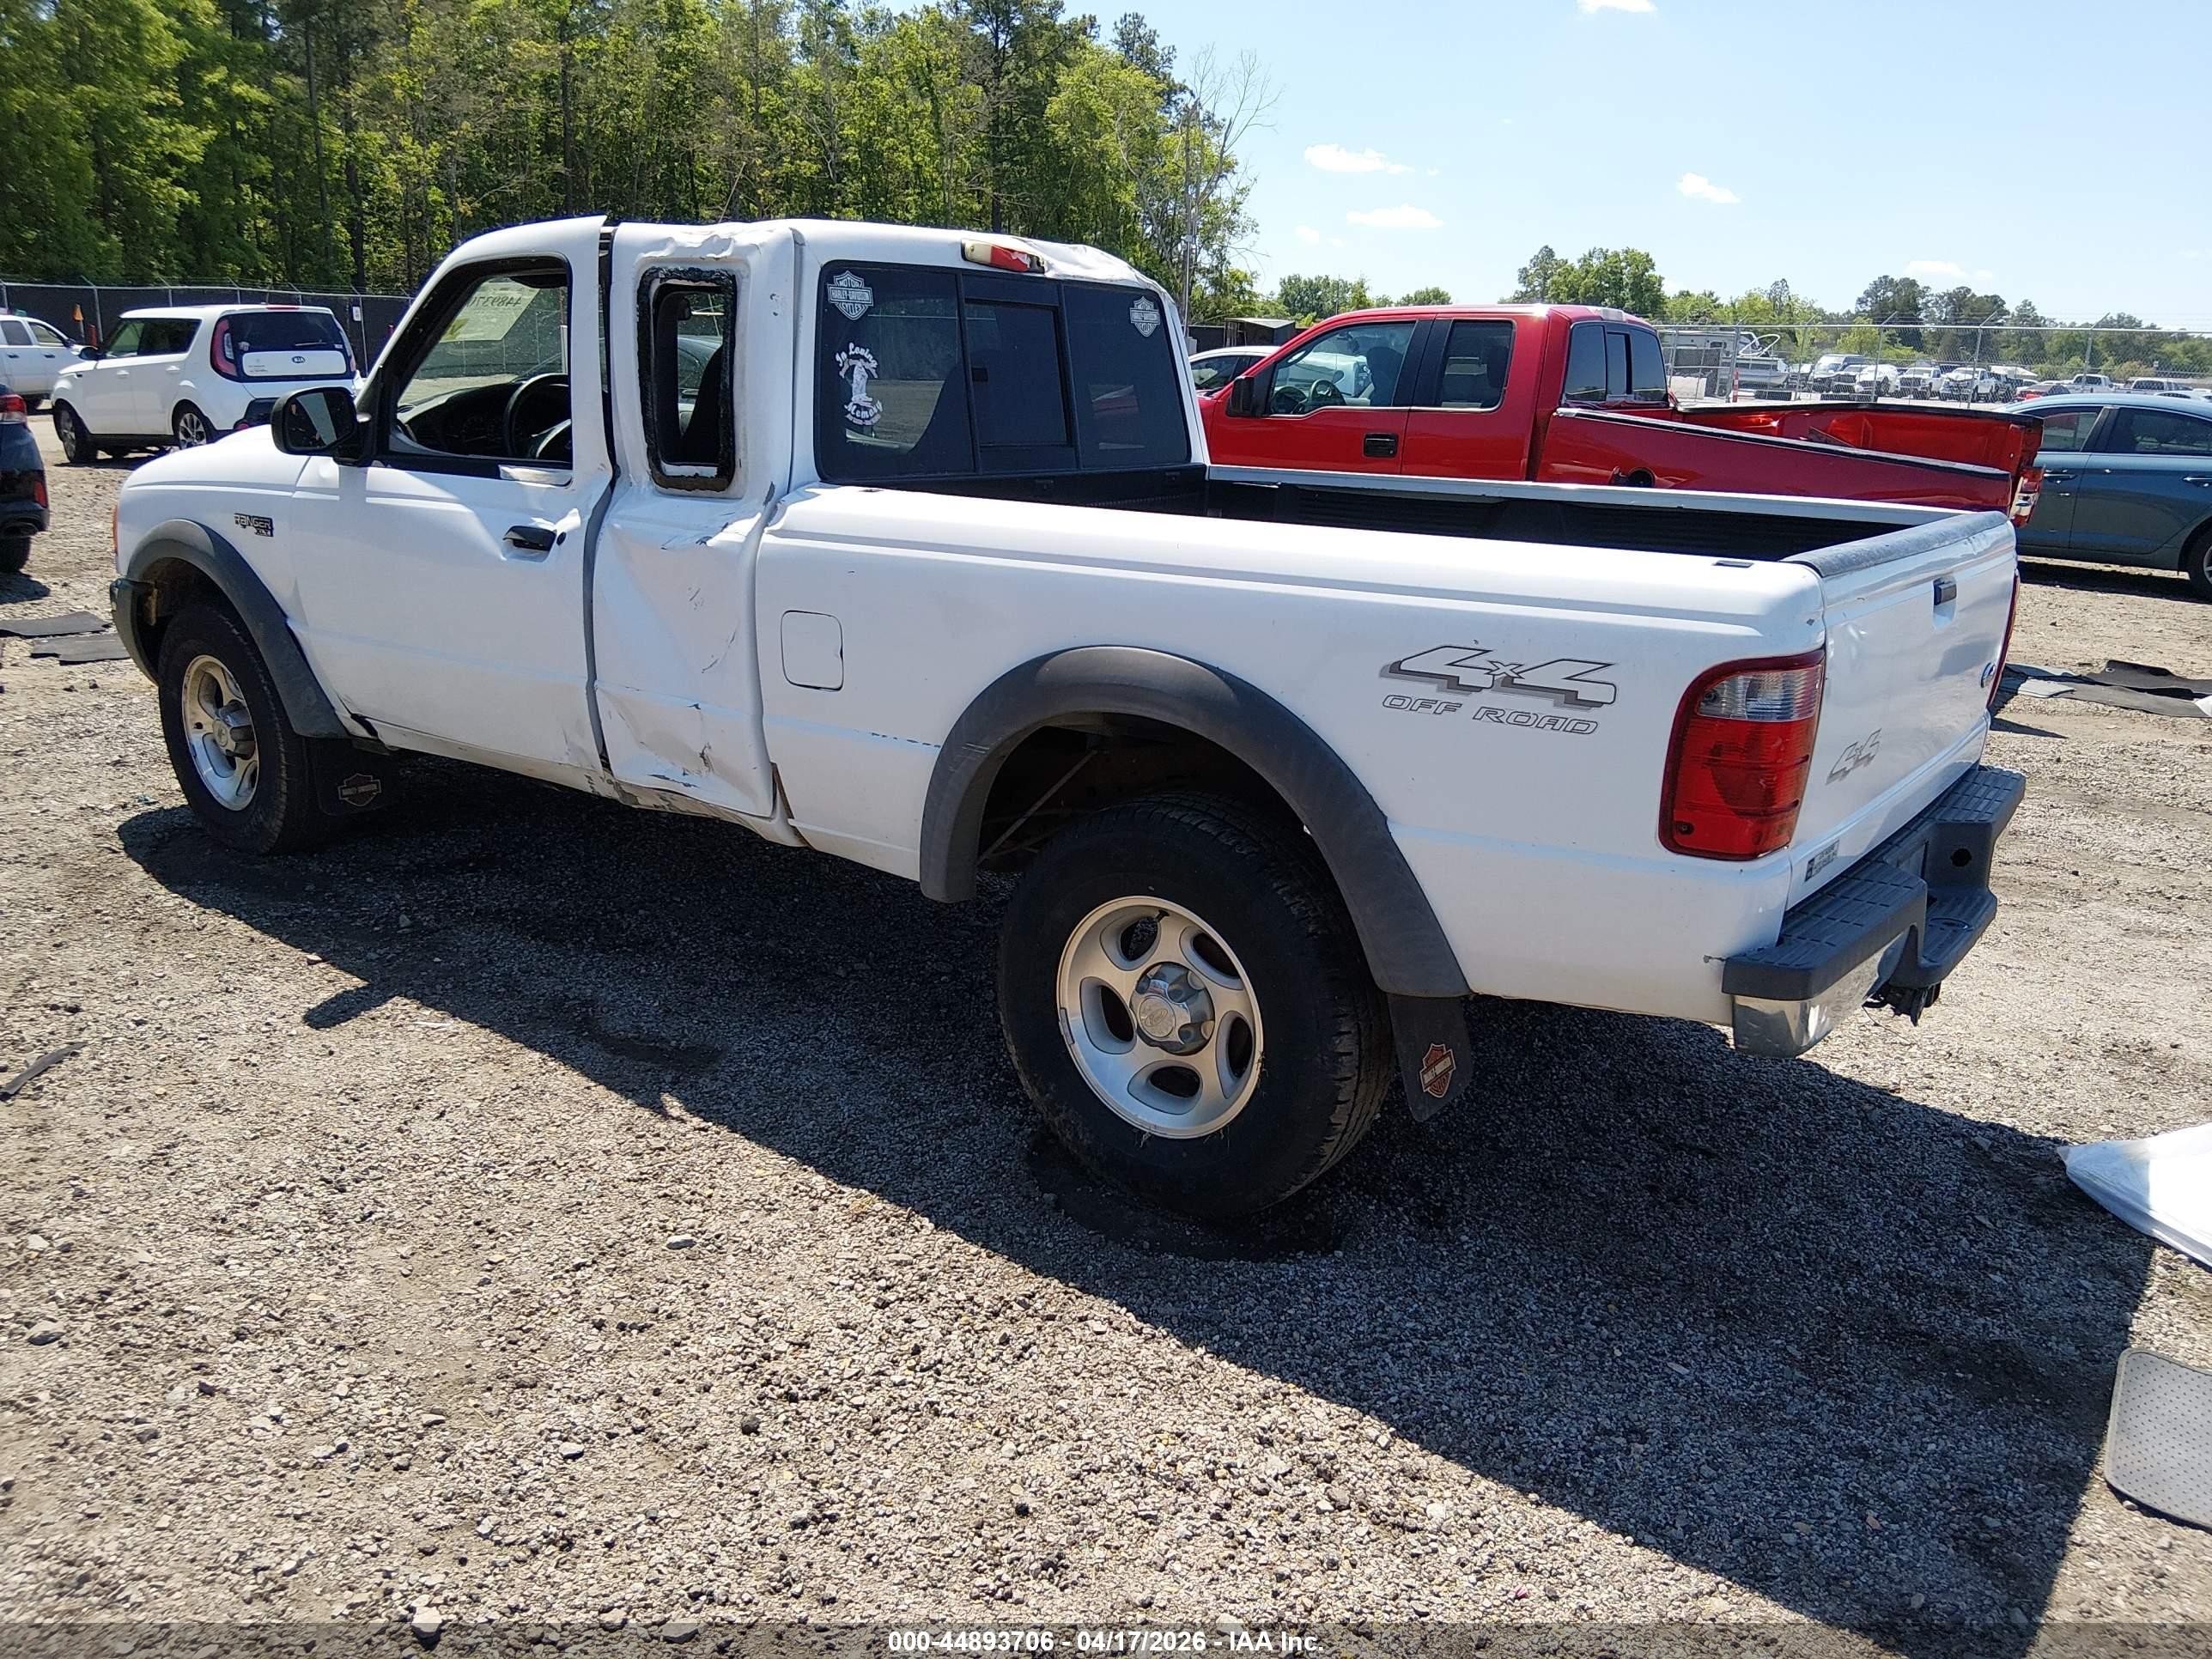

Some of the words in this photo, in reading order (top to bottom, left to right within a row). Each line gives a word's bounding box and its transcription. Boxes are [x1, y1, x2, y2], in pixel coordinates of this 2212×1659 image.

[234, 514, 271, 529] RANGER
[1382, 695, 1462, 715] OFF
[1473, 707, 1599, 735] ROAD
